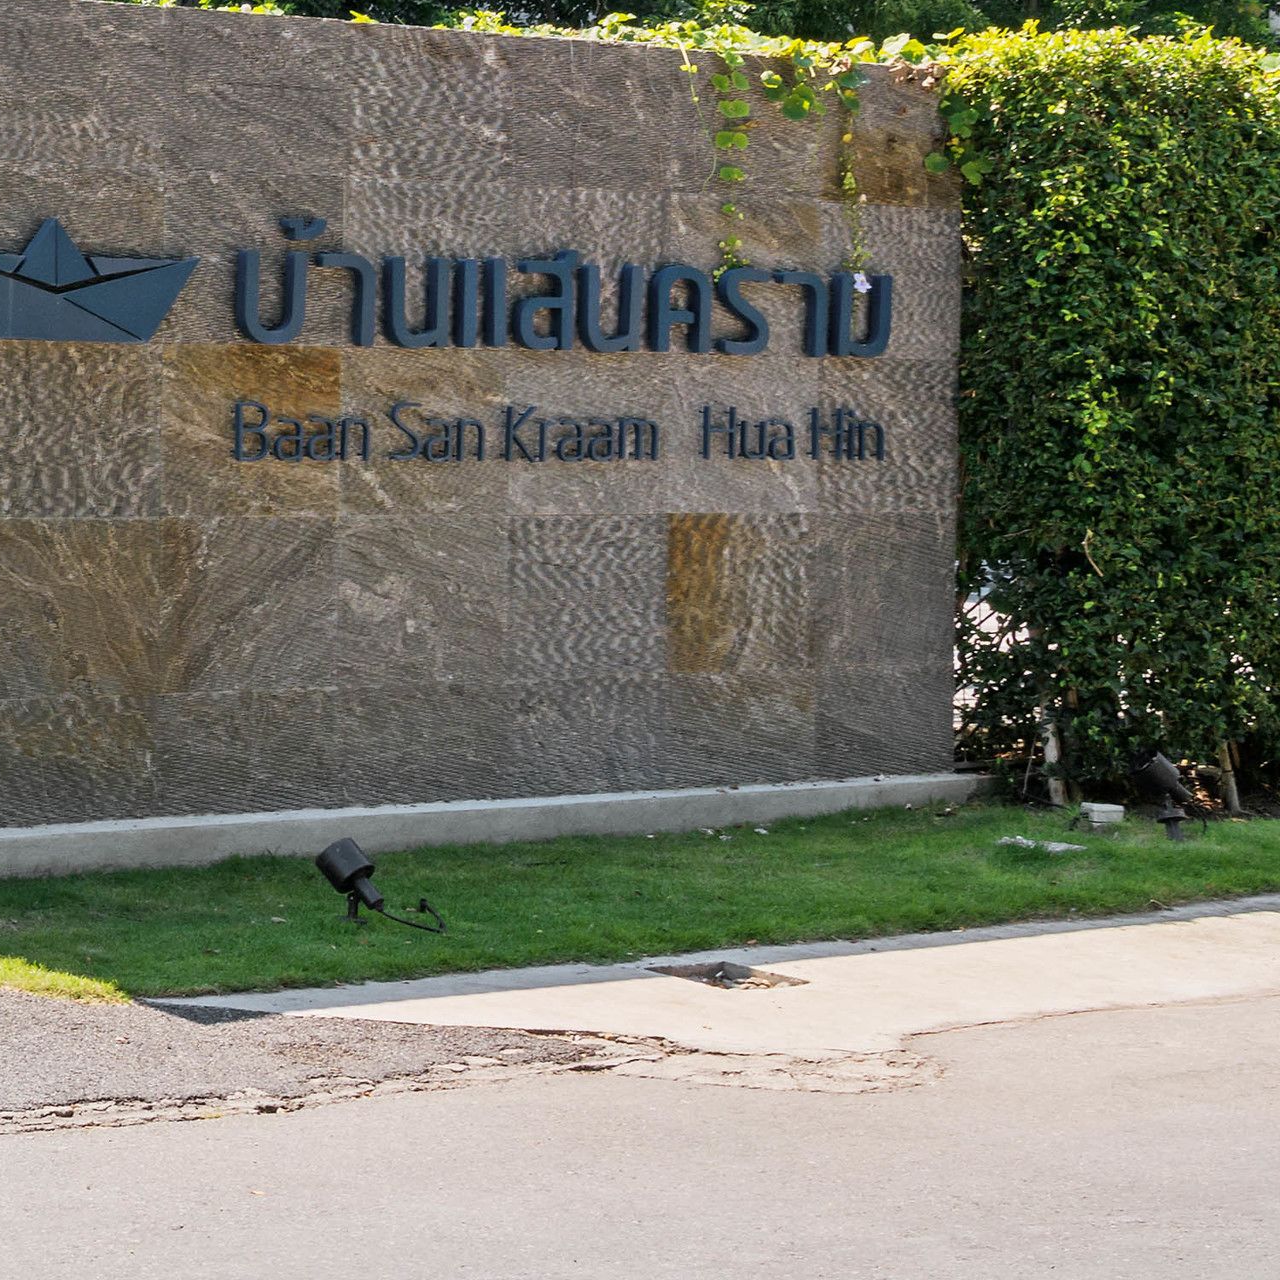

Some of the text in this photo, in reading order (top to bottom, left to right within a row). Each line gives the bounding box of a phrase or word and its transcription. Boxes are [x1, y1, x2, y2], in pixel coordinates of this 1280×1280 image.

[235, 216, 893, 357] บ้านแสนคราม
[231, 400, 886, 463] Baan San Kraam Hua Hin
